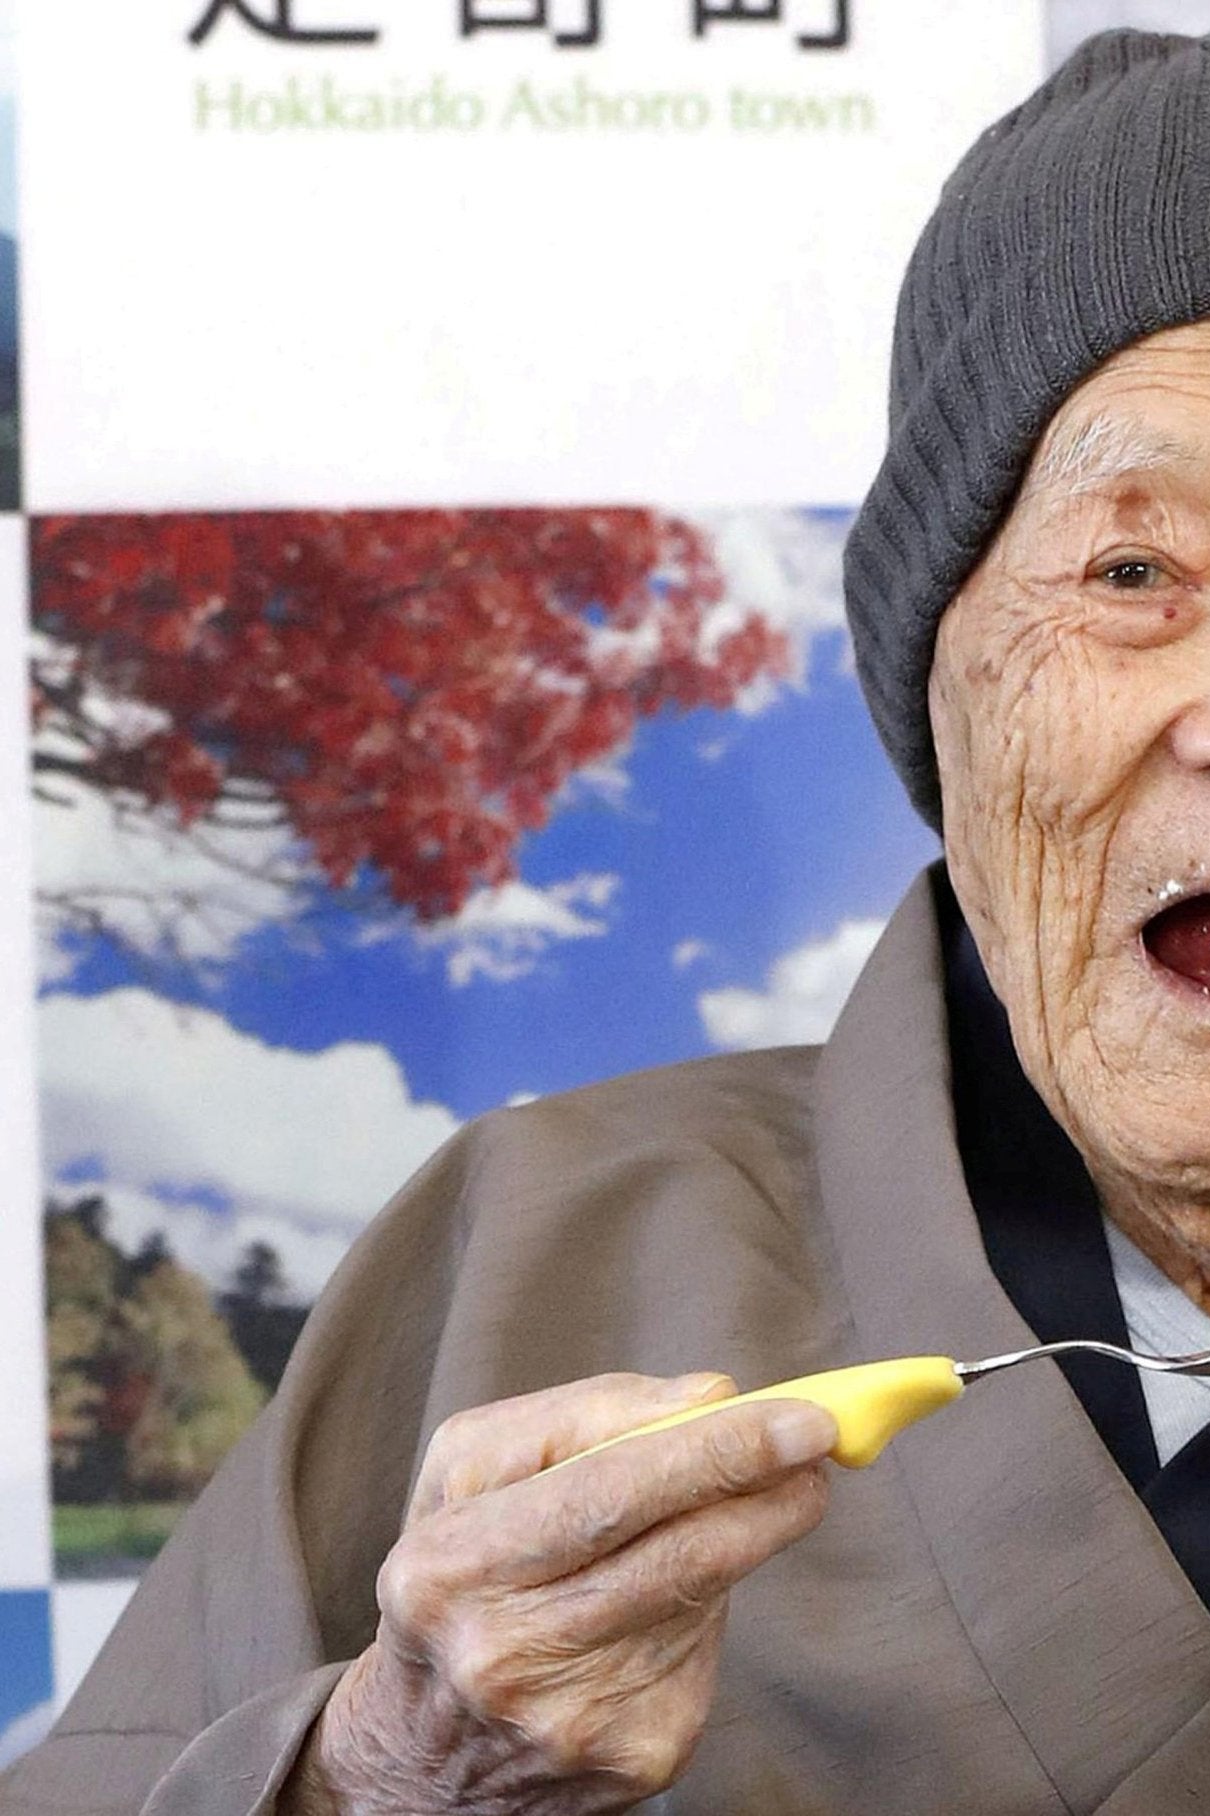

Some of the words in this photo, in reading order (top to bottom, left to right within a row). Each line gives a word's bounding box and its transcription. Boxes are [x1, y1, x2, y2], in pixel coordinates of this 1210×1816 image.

[194, 77, 485, 132] Hokkaido
[502, 77, 709, 132] Ashoro
[728, 86, 877, 132] town
